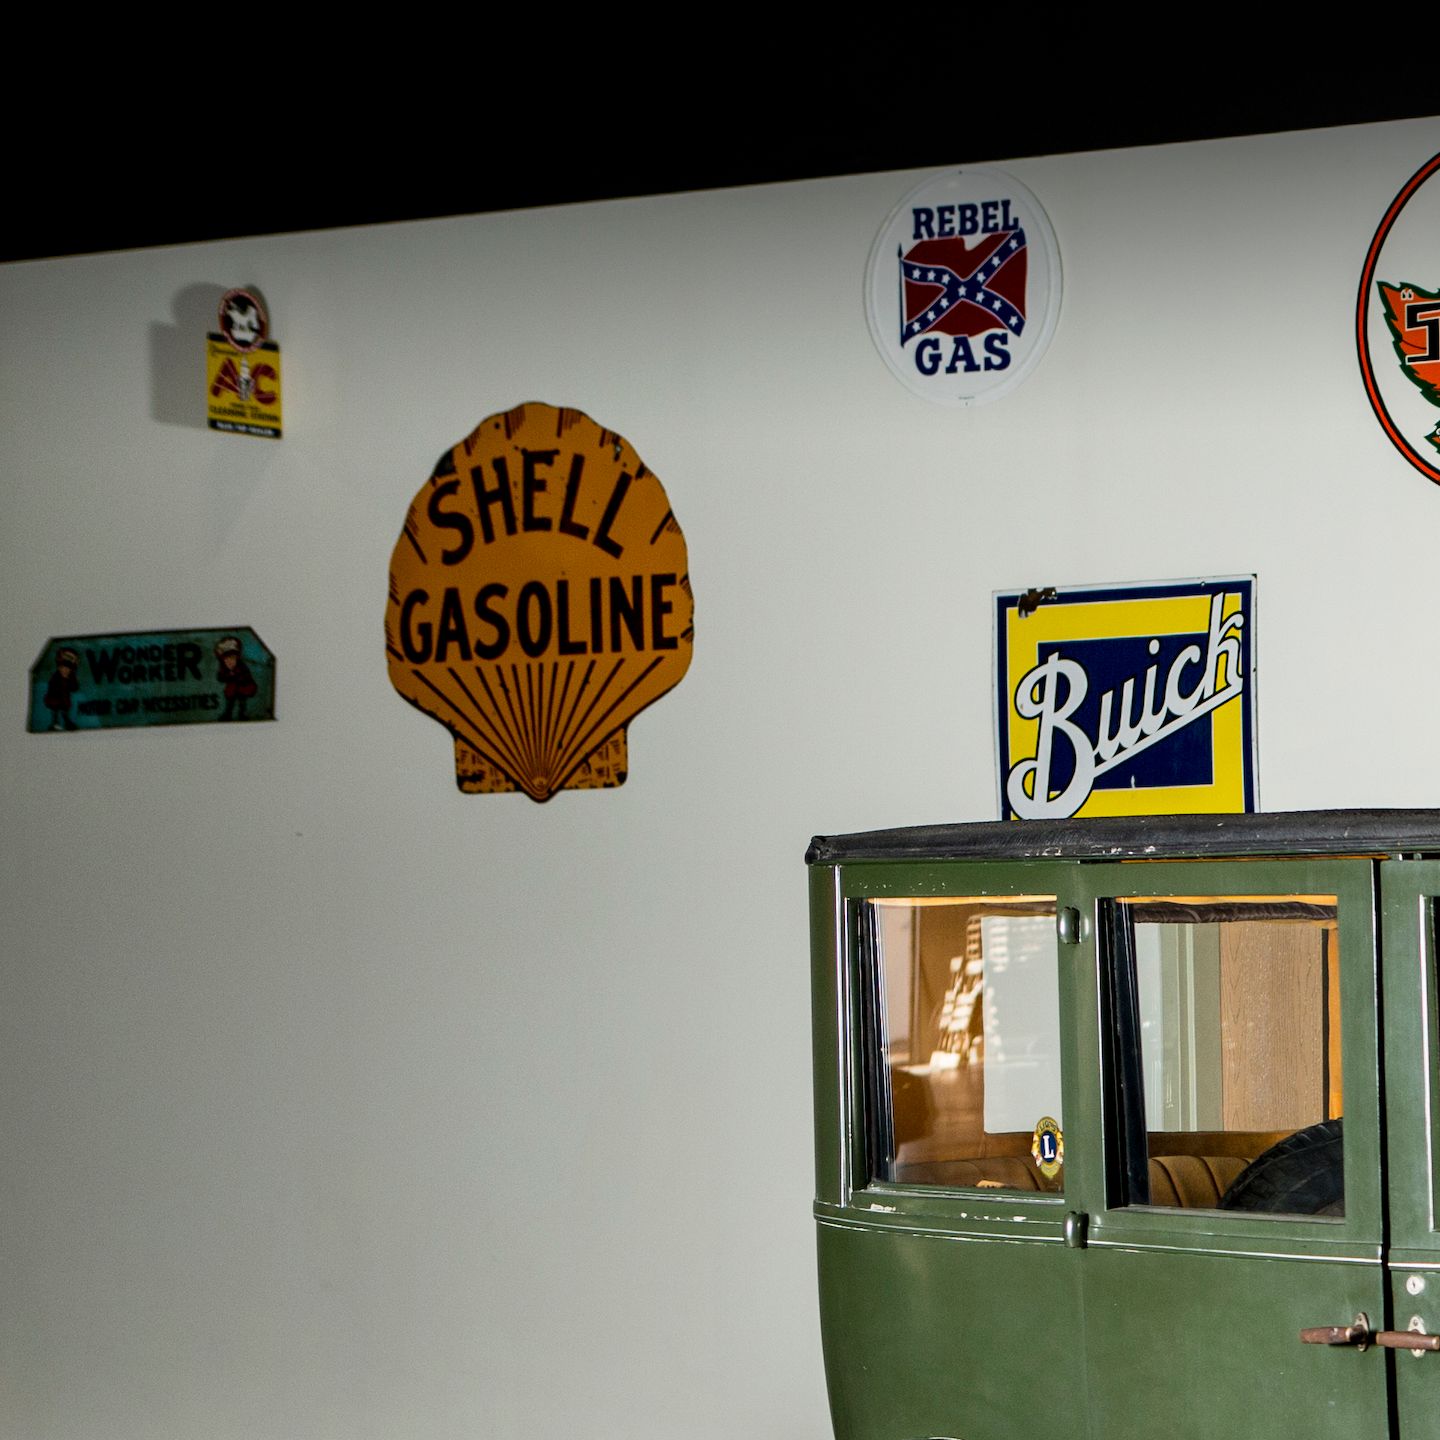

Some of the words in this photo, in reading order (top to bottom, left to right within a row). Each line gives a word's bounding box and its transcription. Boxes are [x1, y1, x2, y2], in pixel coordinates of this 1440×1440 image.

[911, 199, 1021, 241] REBEL
[914, 331, 1013, 377] GAS
[211, 358, 277, 406] AC
[427, 448, 634, 567] SHELL
[400, 572, 679, 665] GASOLINE
[1007, 592, 1244, 821] Buick
[1042, 1134, 1055, 1159] L
